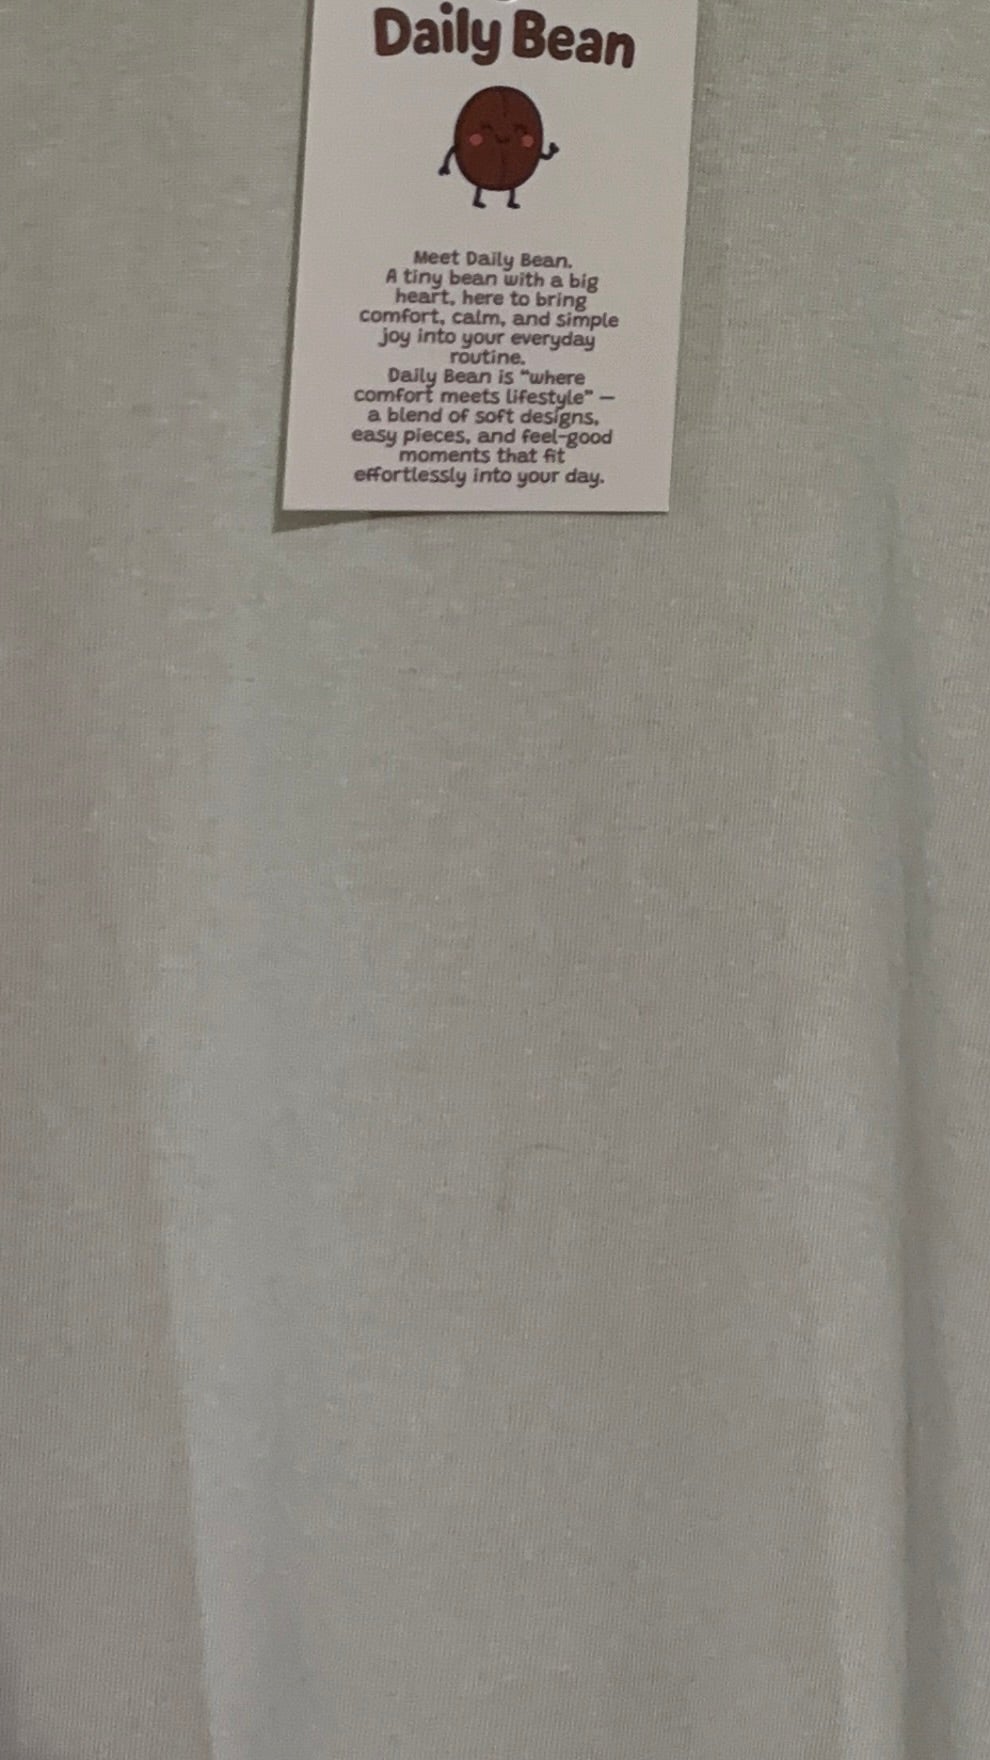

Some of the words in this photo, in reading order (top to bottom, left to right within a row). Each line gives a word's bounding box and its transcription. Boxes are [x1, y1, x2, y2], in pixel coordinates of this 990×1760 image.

[373, 1, 501, 66] Daily
[512, 8, 636, 69] Bean
[413, 249, 461, 266] Meet
[465, 250, 515, 273] Daily
[519, 252, 573, 269] Bean.
[385, 267, 398, 284] A
[402, 267, 443, 290] tiny
[449, 269, 498, 286] bean
[503, 271, 545, 288] with
[550, 275, 564, 289] a
[569, 272, 600, 294] big
[395, 287, 456, 306] heart,
[462, 289, 504, 306] here
[509, 290, 530, 307] to
[535, 291, 588, 313] bring
[359, 307, 446, 326] comfort,
[451, 309, 506, 328] calm,
[512, 311, 551, 327] and
[555, 311, 620, 332] simple
[377, 326, 412, 349] joy
[417, 327, 457, 345] into
[461, 332, 506, 350] your
[510, 331, 596, 353] everyday
[449, 349, 526, 366] routine.
[387, 366, 438, 389] Daily
[443, 368, 492, 384] Bean
[498, 369, 515, 386] is
[519, 369, 586, 386] “where
[353, 386, 435, 405] comfort
[440, 389, 501, 405] meets
[505, 388, 594, 411] lifestyle”
[367, 409, 382, 423] a
[387, 406, 443, 423] blend
[447, 407, 470, 424] of
[474, 408, 514, 425] soft
[519, 406, 601, 430] designs,
[351, 428, 398, 449] easy
[402, 427, 471, 446] pieces,
[477, 428, 516, 444] and
[521, 428, 614, 450] feel-good
[399, 447, 491, 464] moments
[496, 447, 538, 464] that
[542, 447, 566, 464] fit
[353, 465, 467, 489] effortlessly
[472, 466, 513, 484] into
[516, 470, 561, 489] your
[564, 467, 605, 490] day.
